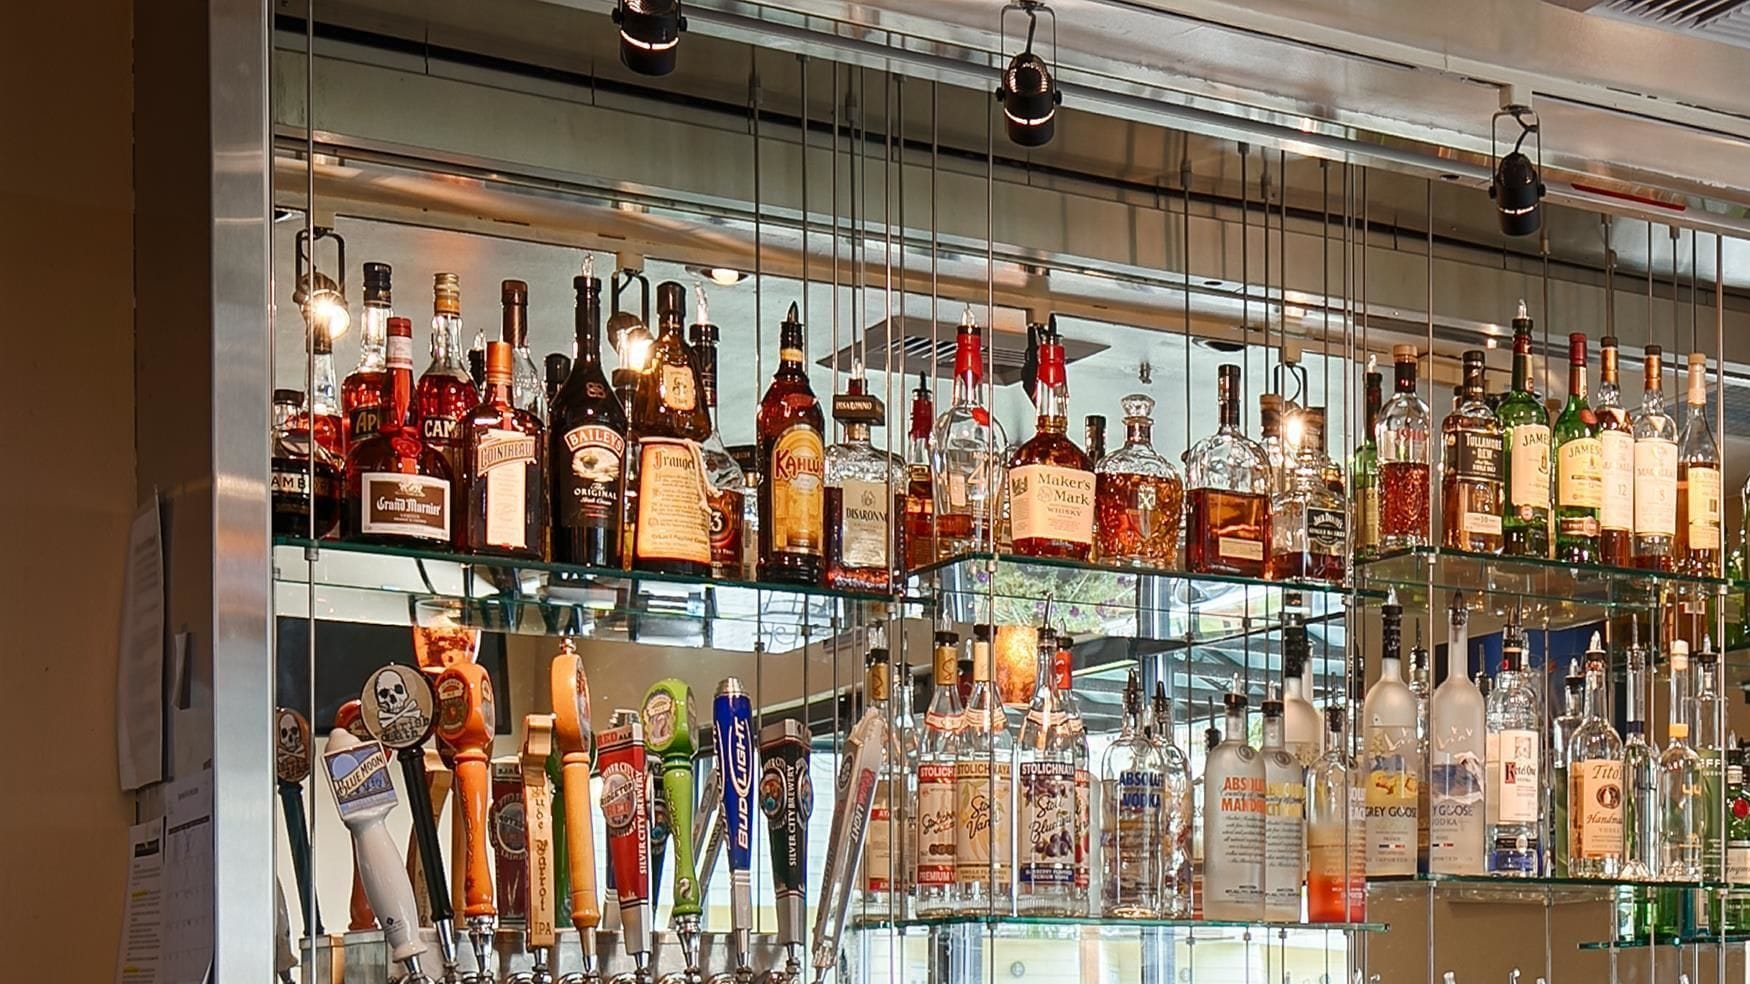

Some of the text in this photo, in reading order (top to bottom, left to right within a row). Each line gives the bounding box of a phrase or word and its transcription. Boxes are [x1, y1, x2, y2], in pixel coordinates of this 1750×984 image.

[569, 427, 622, 451] BAILEYS
[480, 441, 531, 470] COINTREAU
[1037, 473, 1091, 490] Maker's
[573, 488, 617, 500] ORIGINAL
[1053, 490, 1090, 506] Mark
[376, 496, 442, 516] Grand Marnier
[597, 732, 633, 747] RED ALE
[735, 716, 747, 786] LIGHT
[361, 753, 383, 776] MOON
[336, 773, 362, 797] BLUE
[1122, 793, 1161, 808] VODKA
[636, 770, 648, 875] BREWERY CITY SILVER
[737, 803, 749, 850] BUD
[786, 765, 797, 867] BREWERY CITY SILVER
[851, 805, 865, 844] LIGHT
[535, 922, 552, 935] IPA
